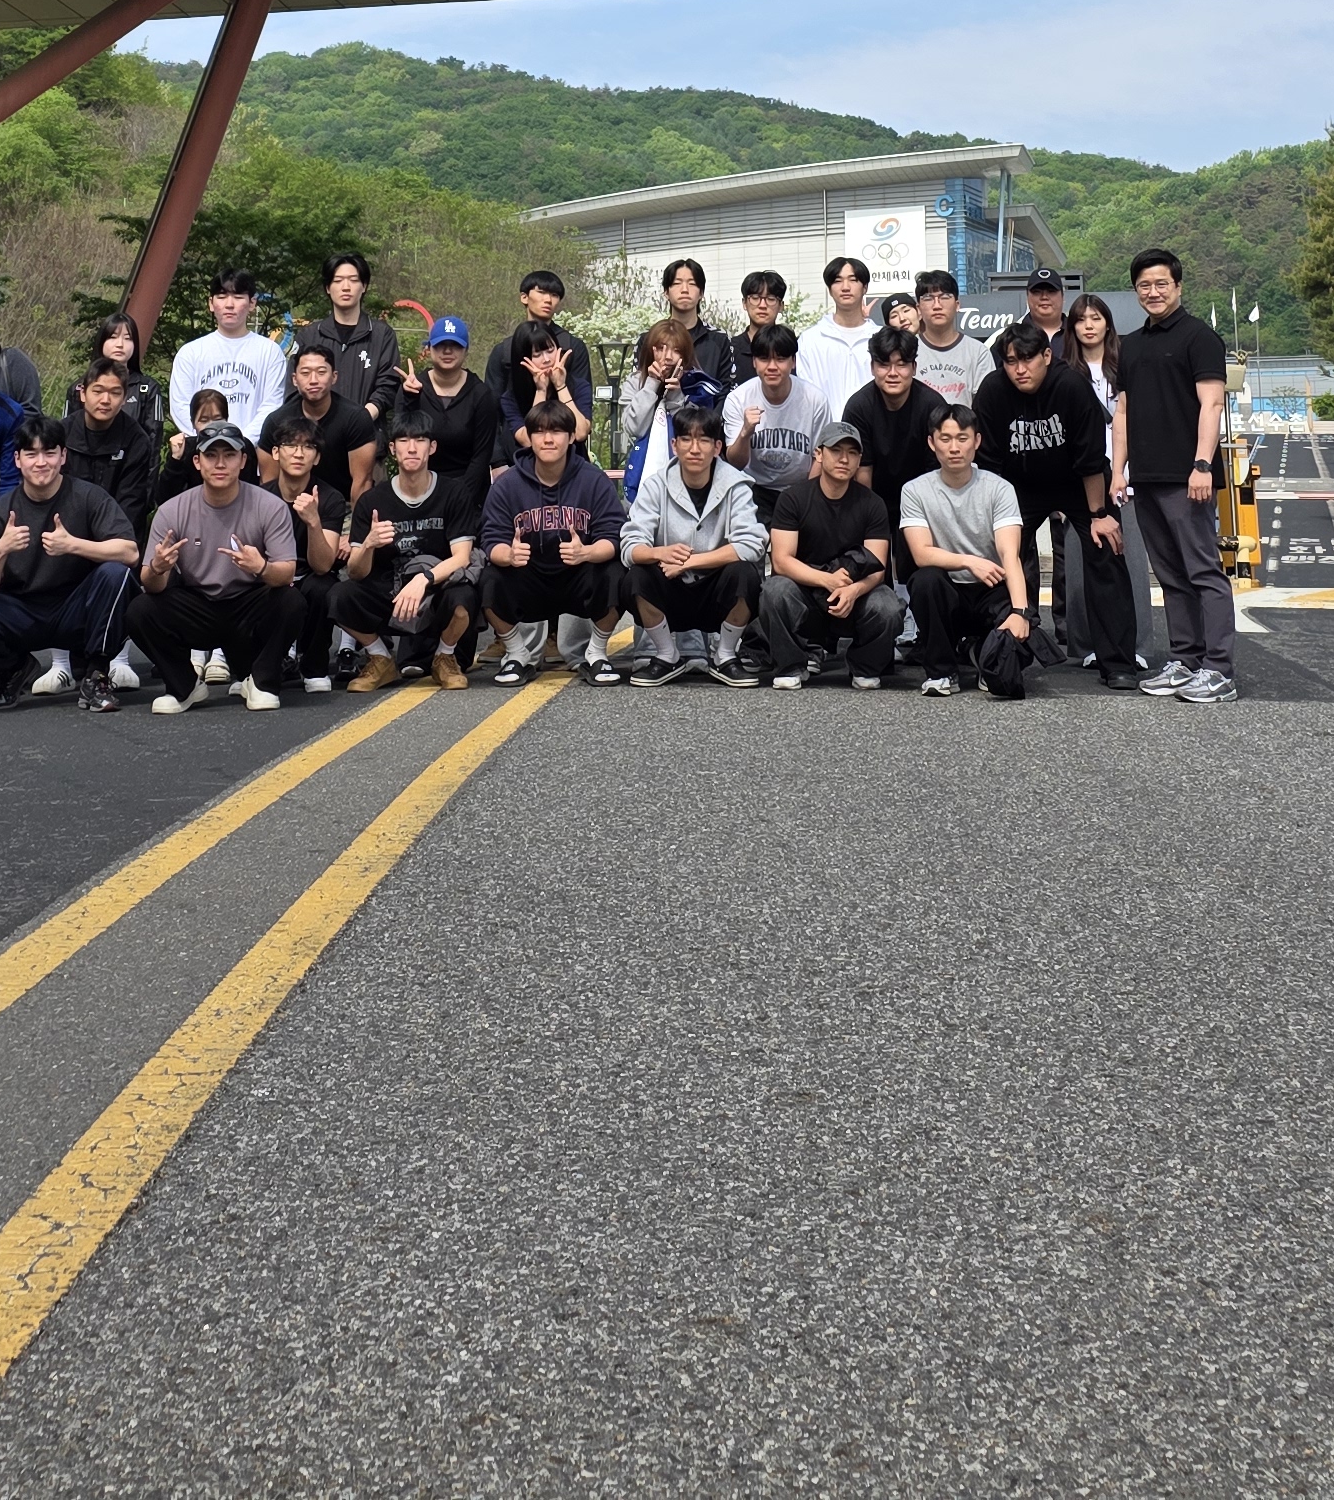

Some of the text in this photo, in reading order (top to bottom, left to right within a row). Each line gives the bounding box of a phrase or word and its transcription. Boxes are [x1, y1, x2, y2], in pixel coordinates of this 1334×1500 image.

[935, 195, 955, 217] C
[871, 270, 910, 282] 한체육회
[444, 320, 456, 333] LA
[958, 307, 1014, 330] Team
[200, 361, 257, 389] SAINT LOUIS
[919, 367, 928, 376] MY
[750, 428, 810, 455] ONVOYAGE
[514, 505, 591, 536] COVERNAT
